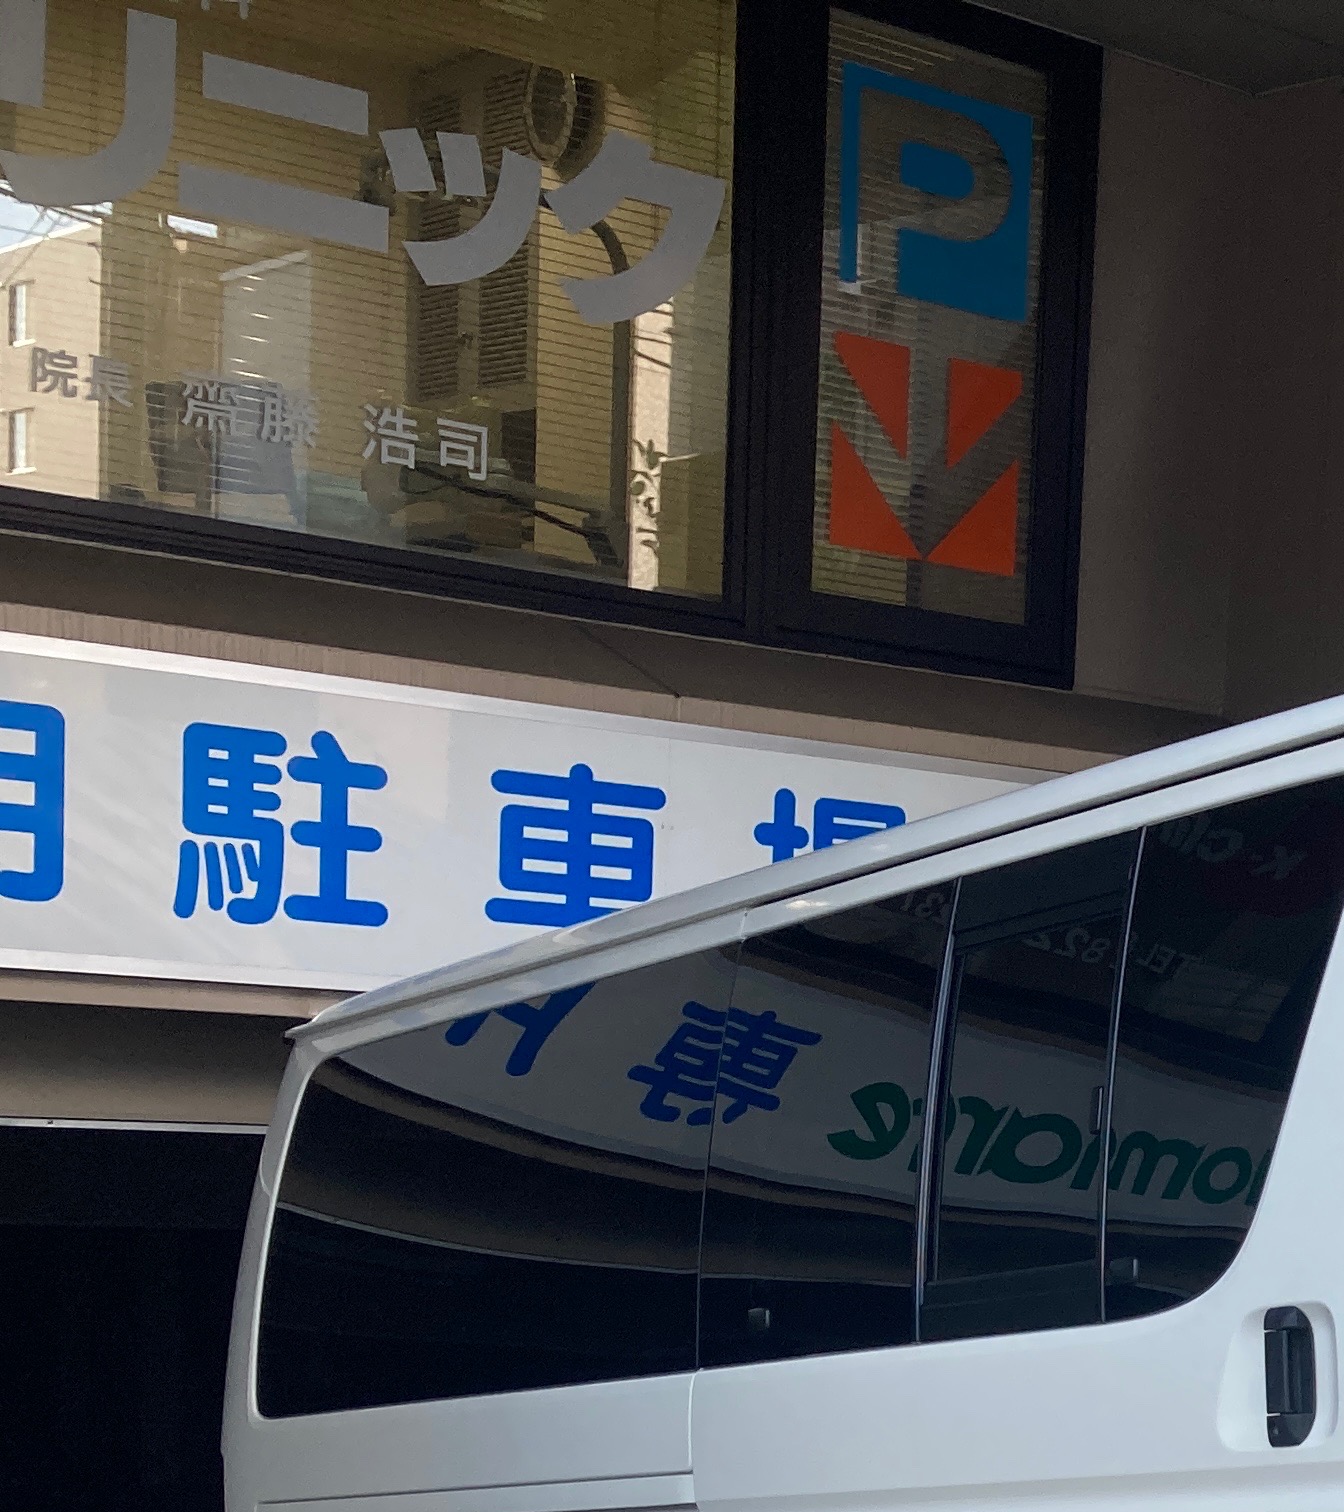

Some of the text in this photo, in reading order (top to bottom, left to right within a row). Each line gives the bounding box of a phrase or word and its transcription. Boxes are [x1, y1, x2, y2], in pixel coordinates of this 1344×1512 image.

[856, 80, 1014, 294] P
[30, 346, 133, 407] 院長
[362, 403, 489, 481] 浩司
